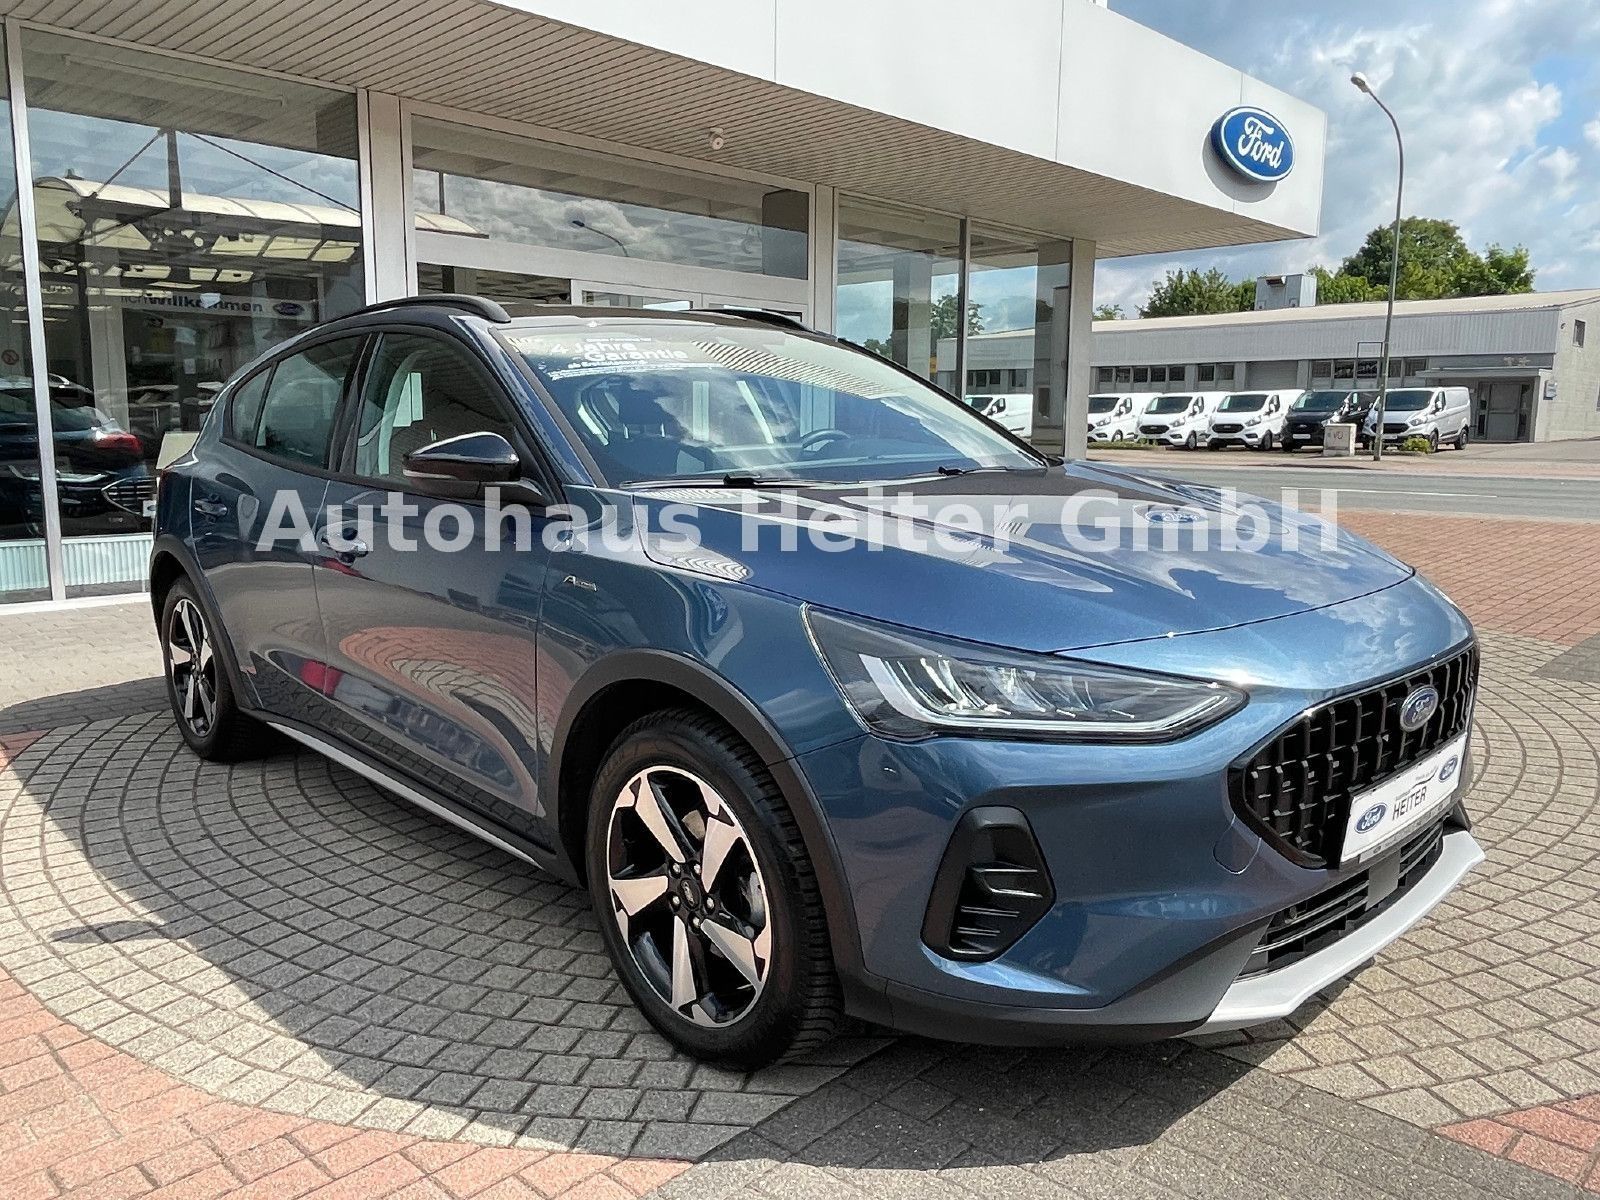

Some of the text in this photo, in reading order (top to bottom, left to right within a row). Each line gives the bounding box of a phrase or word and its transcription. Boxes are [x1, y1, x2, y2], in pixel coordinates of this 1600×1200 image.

[1237, 116, 1285, 169] Ford
[574, 341, 638, 353] Jahre
[583, 349, 689, 361] Garantie
[1392, 785, 1428, 821] HEITER
